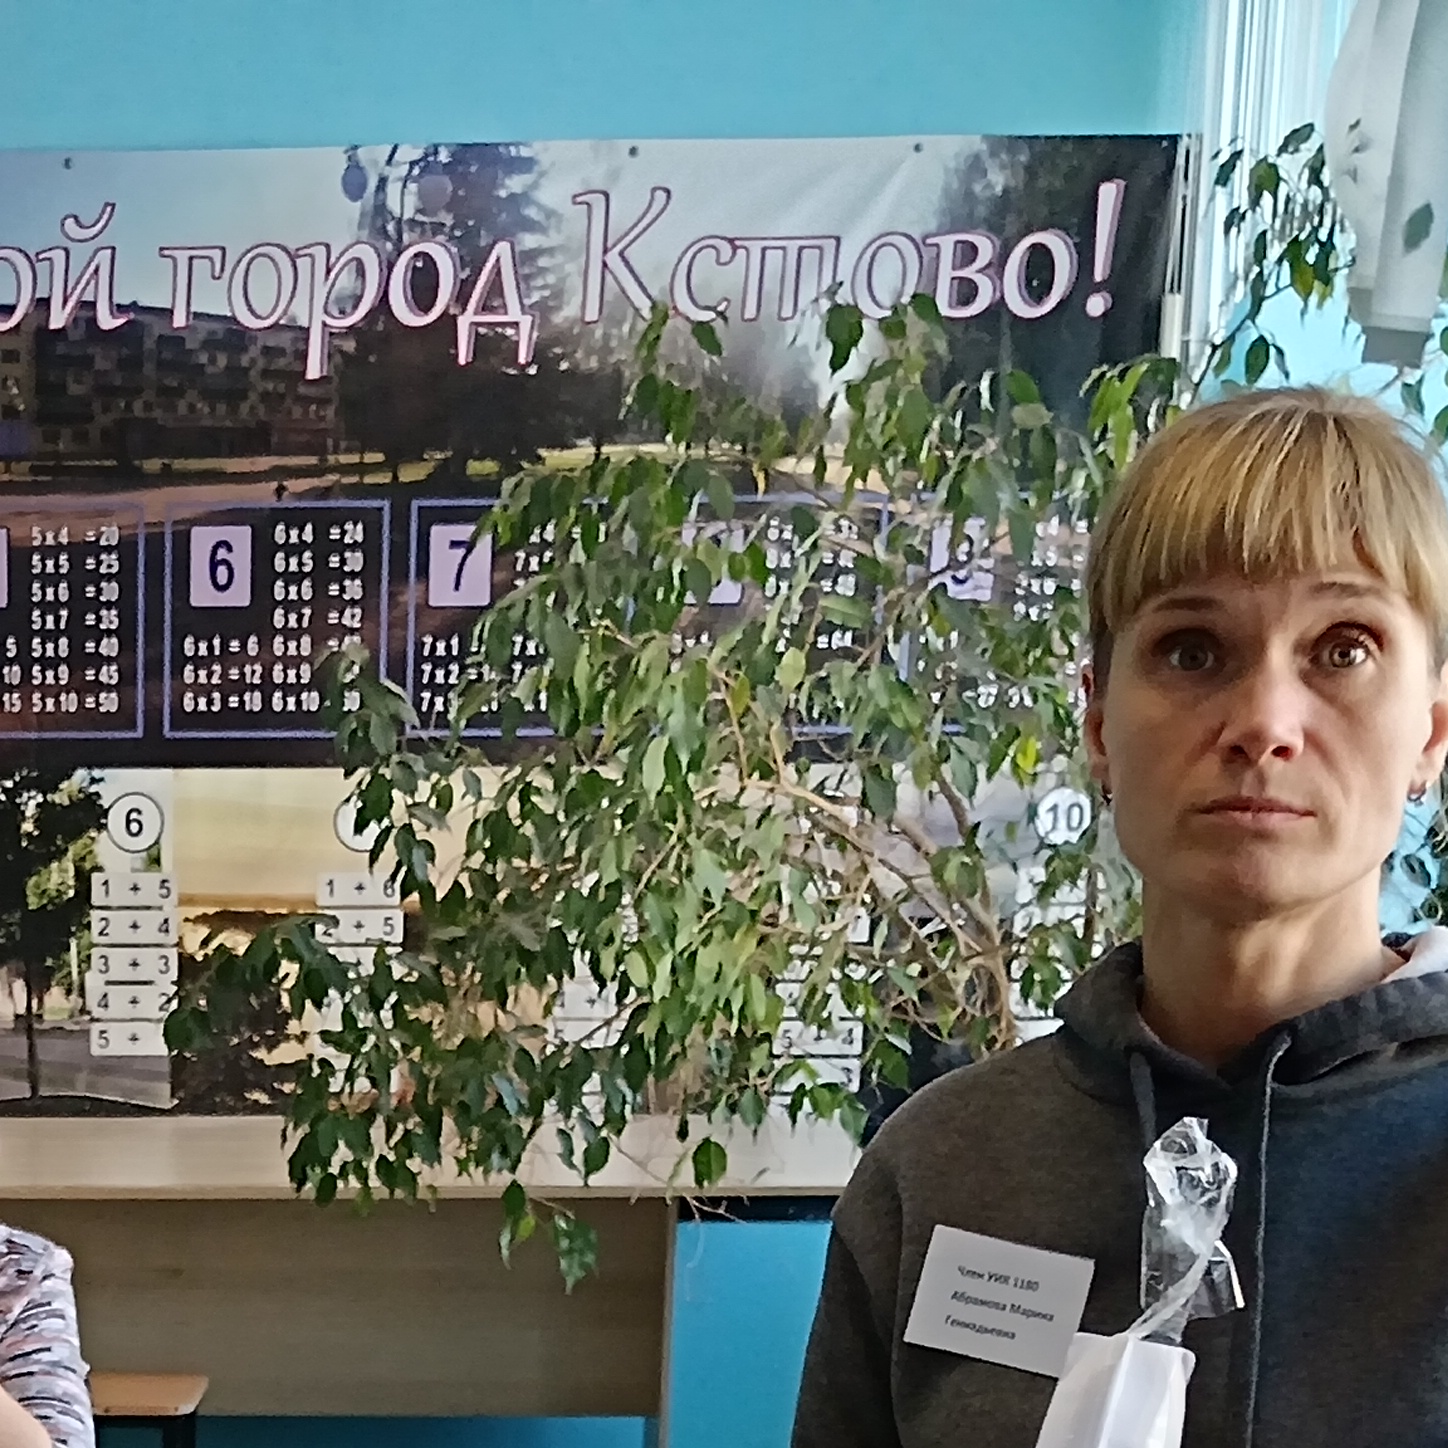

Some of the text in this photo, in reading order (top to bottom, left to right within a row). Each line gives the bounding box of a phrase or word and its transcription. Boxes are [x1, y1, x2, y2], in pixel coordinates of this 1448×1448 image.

[159, 240, 538, 380] город
[572, 177, 1126, 322] Кстово!
[209, 539, 234, 592] 6
[449, 539, 476, 592] 7
[123, 808, 144, 838] 6
[1044, 803, 1084, 832] 10
[99, 878, 110, 899] 1
[157, 878, 171, 899] 5
[326, 878, 336, 900] 1
[97, 916, 111, 937] 2
[156, 916, 171, 937] 4
[381, 916, 396, 937] 5
[97, 953, 111, 975] 3
[157, 953, 171, 975] 3
[95, 991, 111, 1012] 4
[96, 1028, 110, 1050] 5
